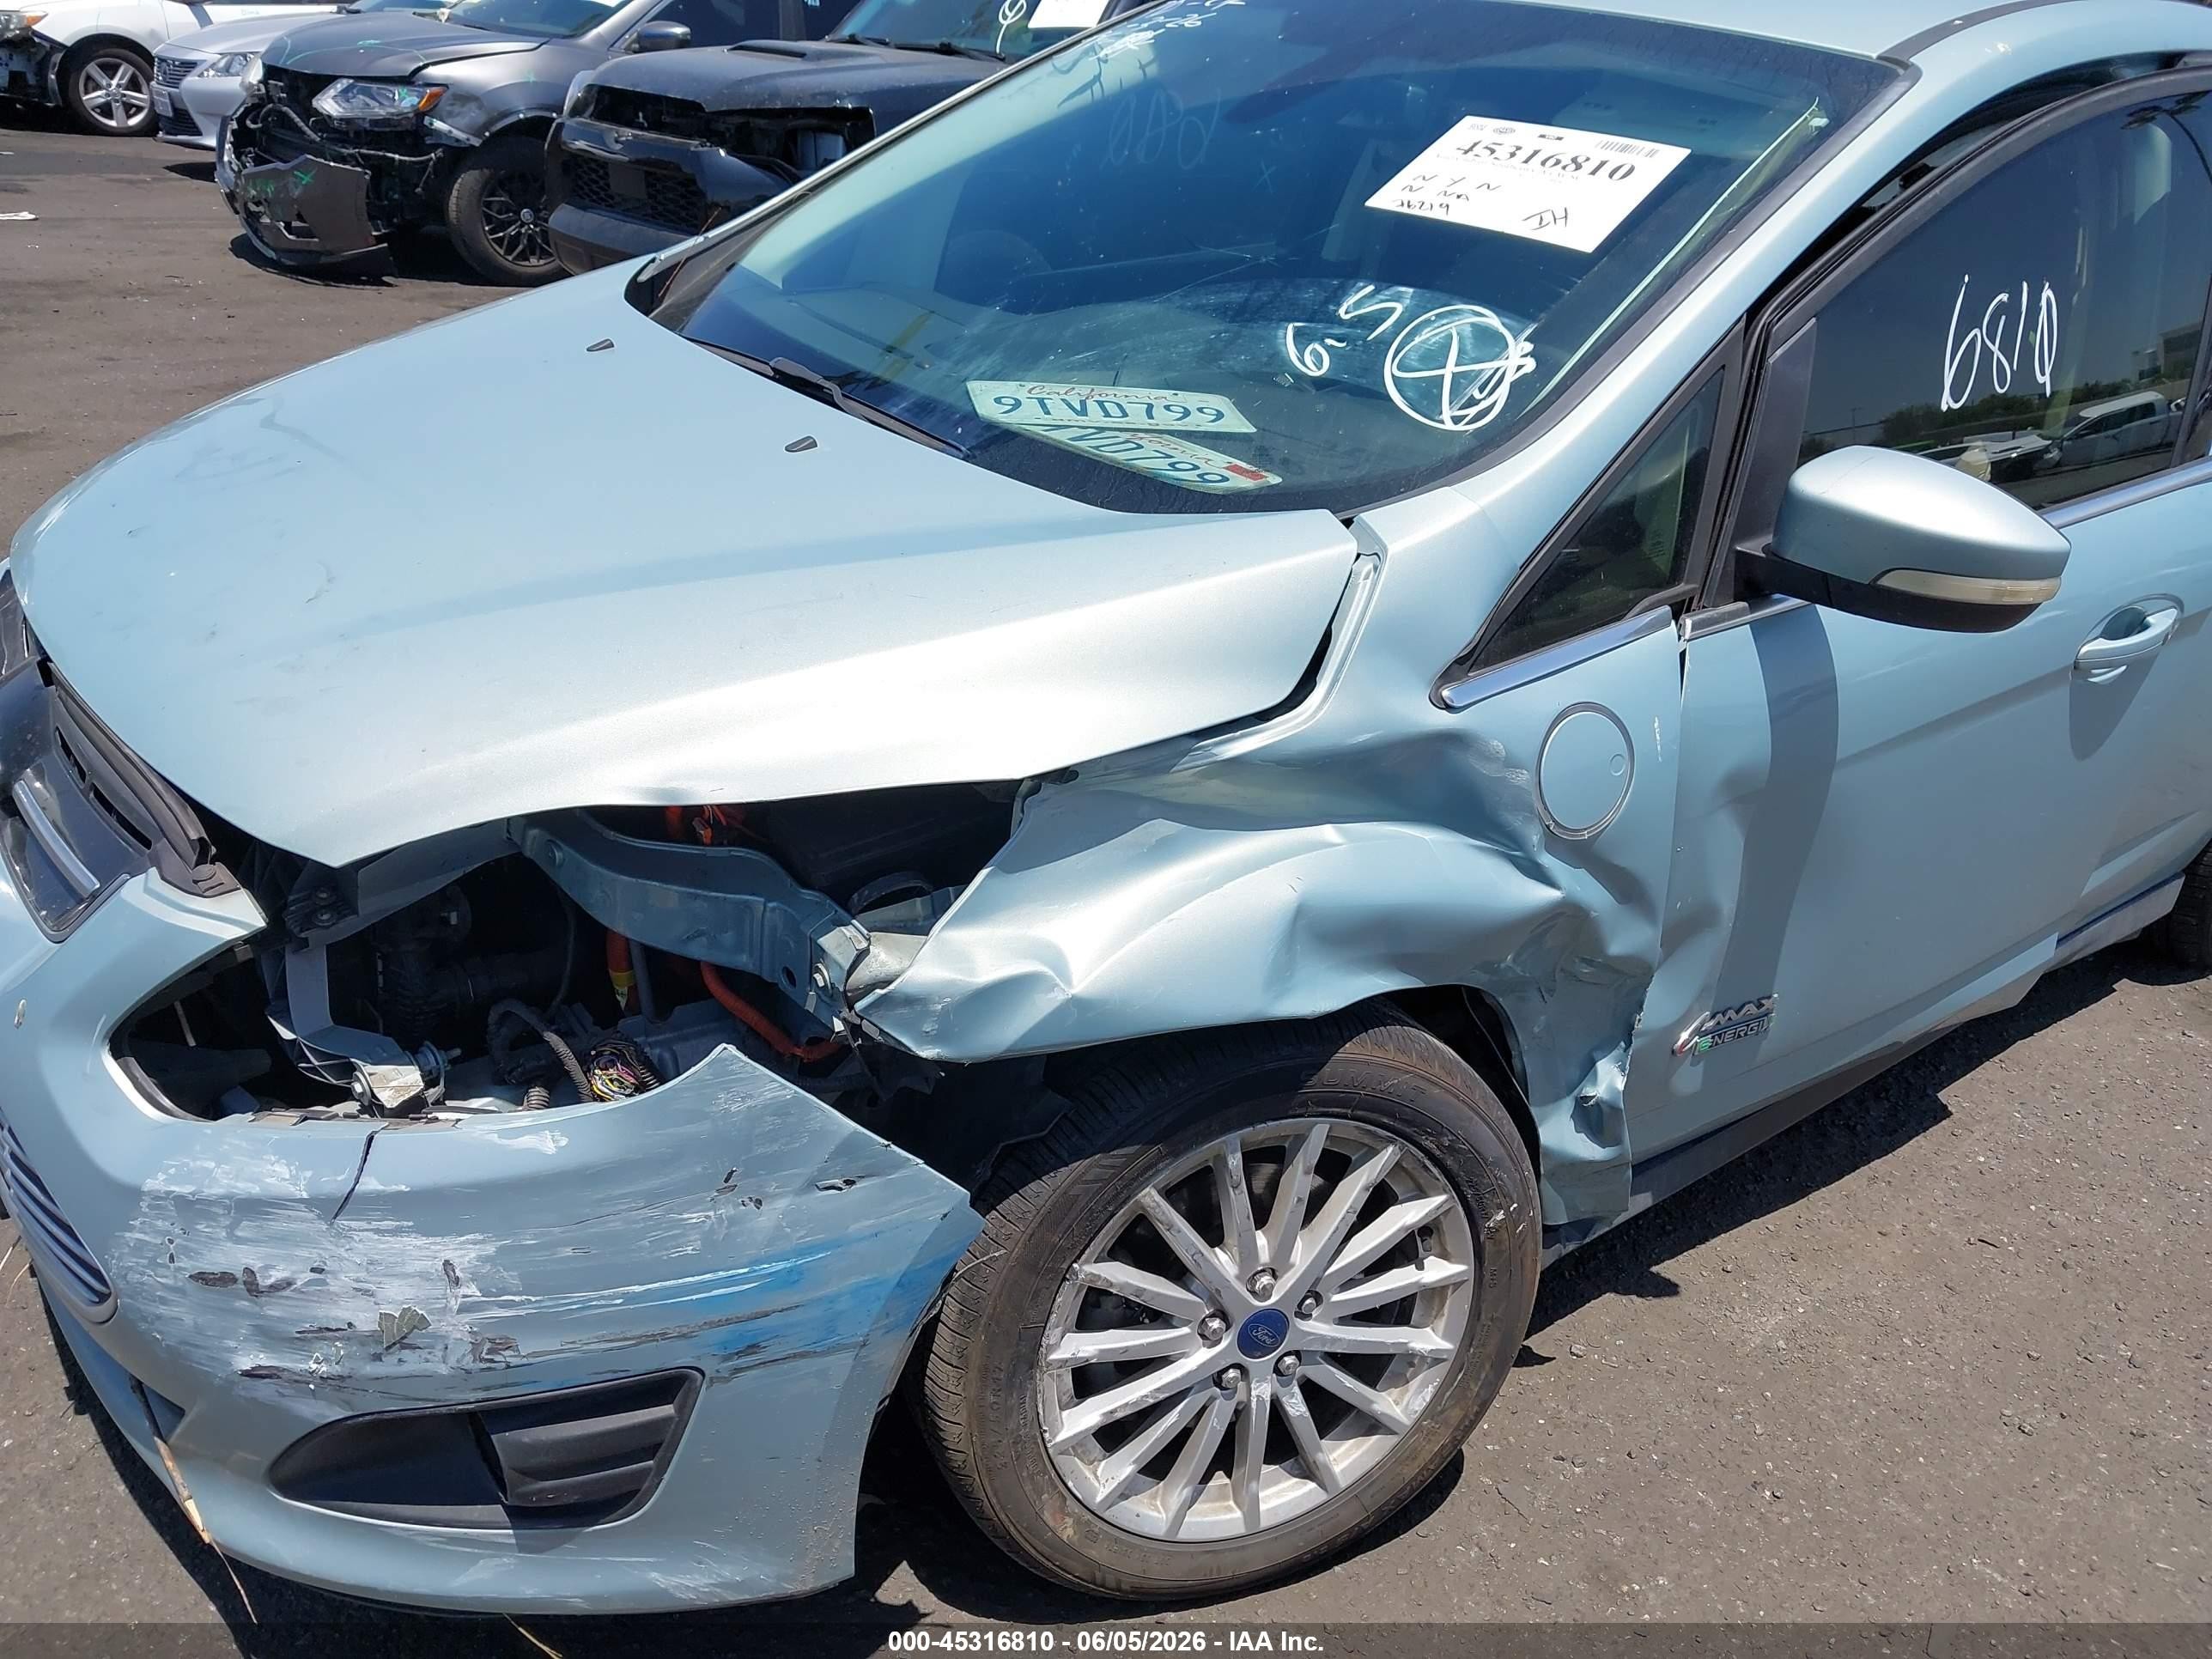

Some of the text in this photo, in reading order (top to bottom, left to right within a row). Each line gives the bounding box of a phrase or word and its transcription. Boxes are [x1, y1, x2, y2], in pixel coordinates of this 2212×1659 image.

[1456, 139, 1636, 181] 45316810
[1940, 273, 2059, 412] 6810
[1026, 384, 1173, 404] California
[993, 395, 1225, 423] 9TVD799
[1252, 1326, 1277, 1346] Ford
